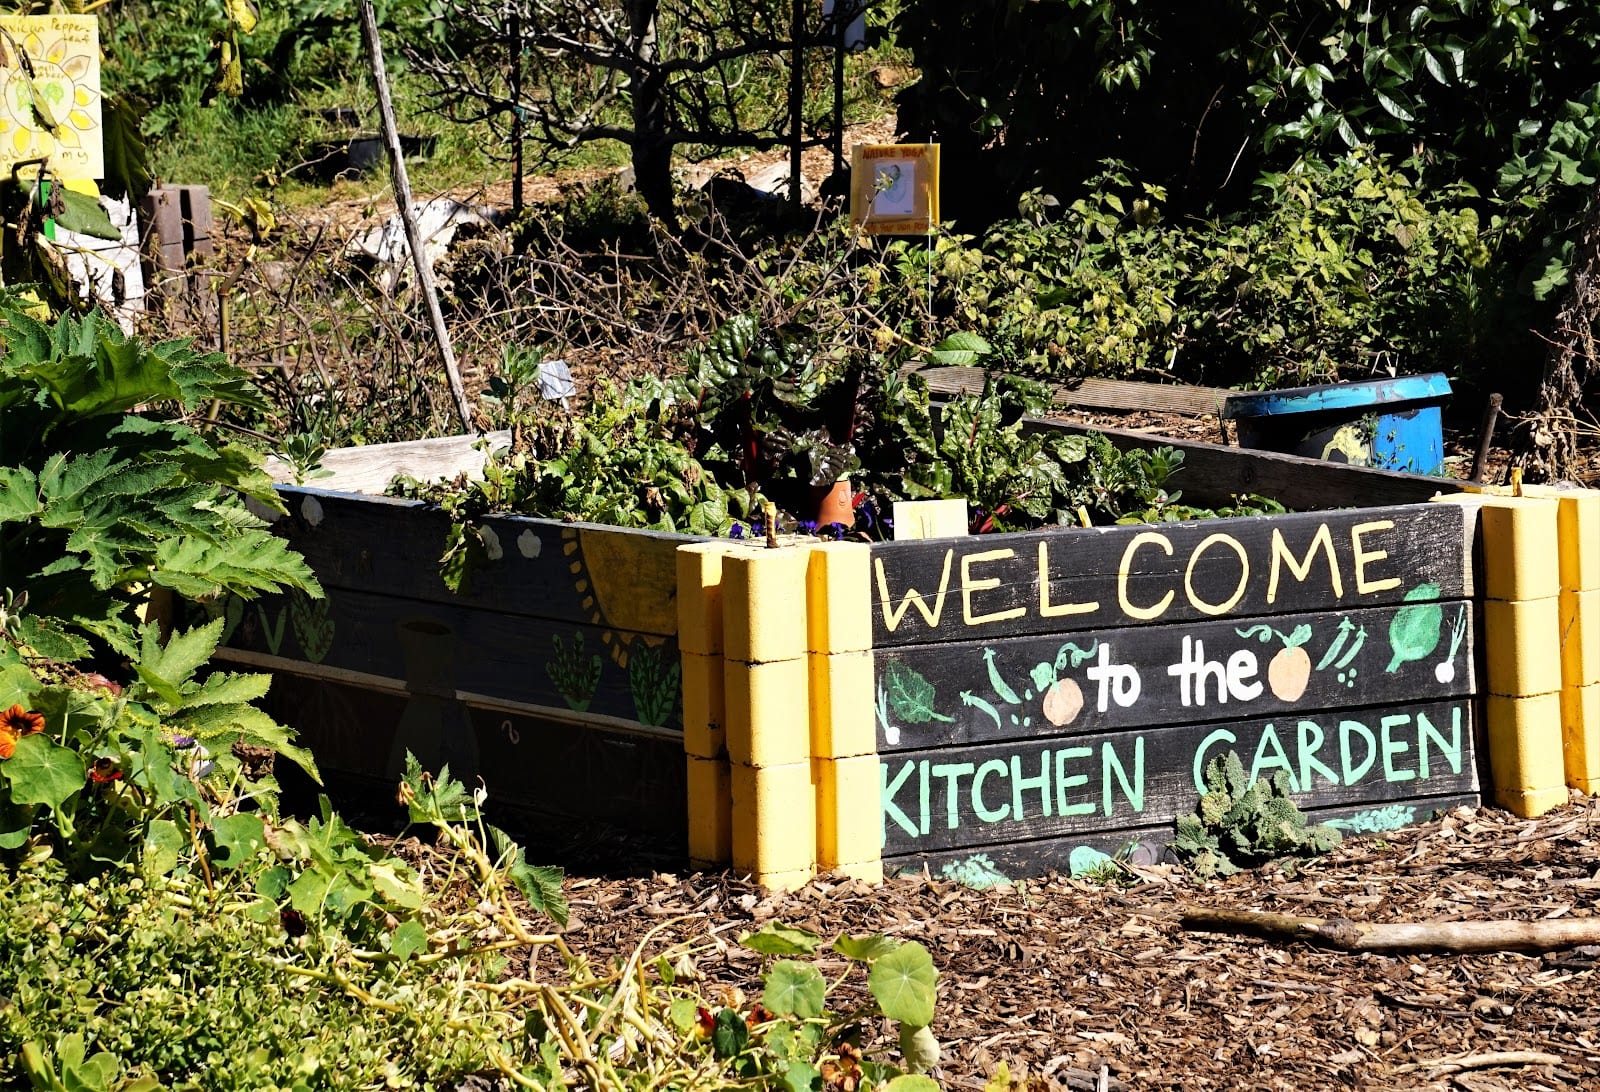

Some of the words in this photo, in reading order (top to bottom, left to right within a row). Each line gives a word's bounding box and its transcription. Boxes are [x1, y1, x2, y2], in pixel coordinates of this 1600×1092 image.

[62, 151, 88, 165] my
[874, 520, 1402, 633] WELCOME
[1087, 642, 1141, 713] to
[1167, 635, 1264, 706] the
[880, 736, 1145, 849] KITCHEN
[1193, 706, 1462, 797] GARDEN
